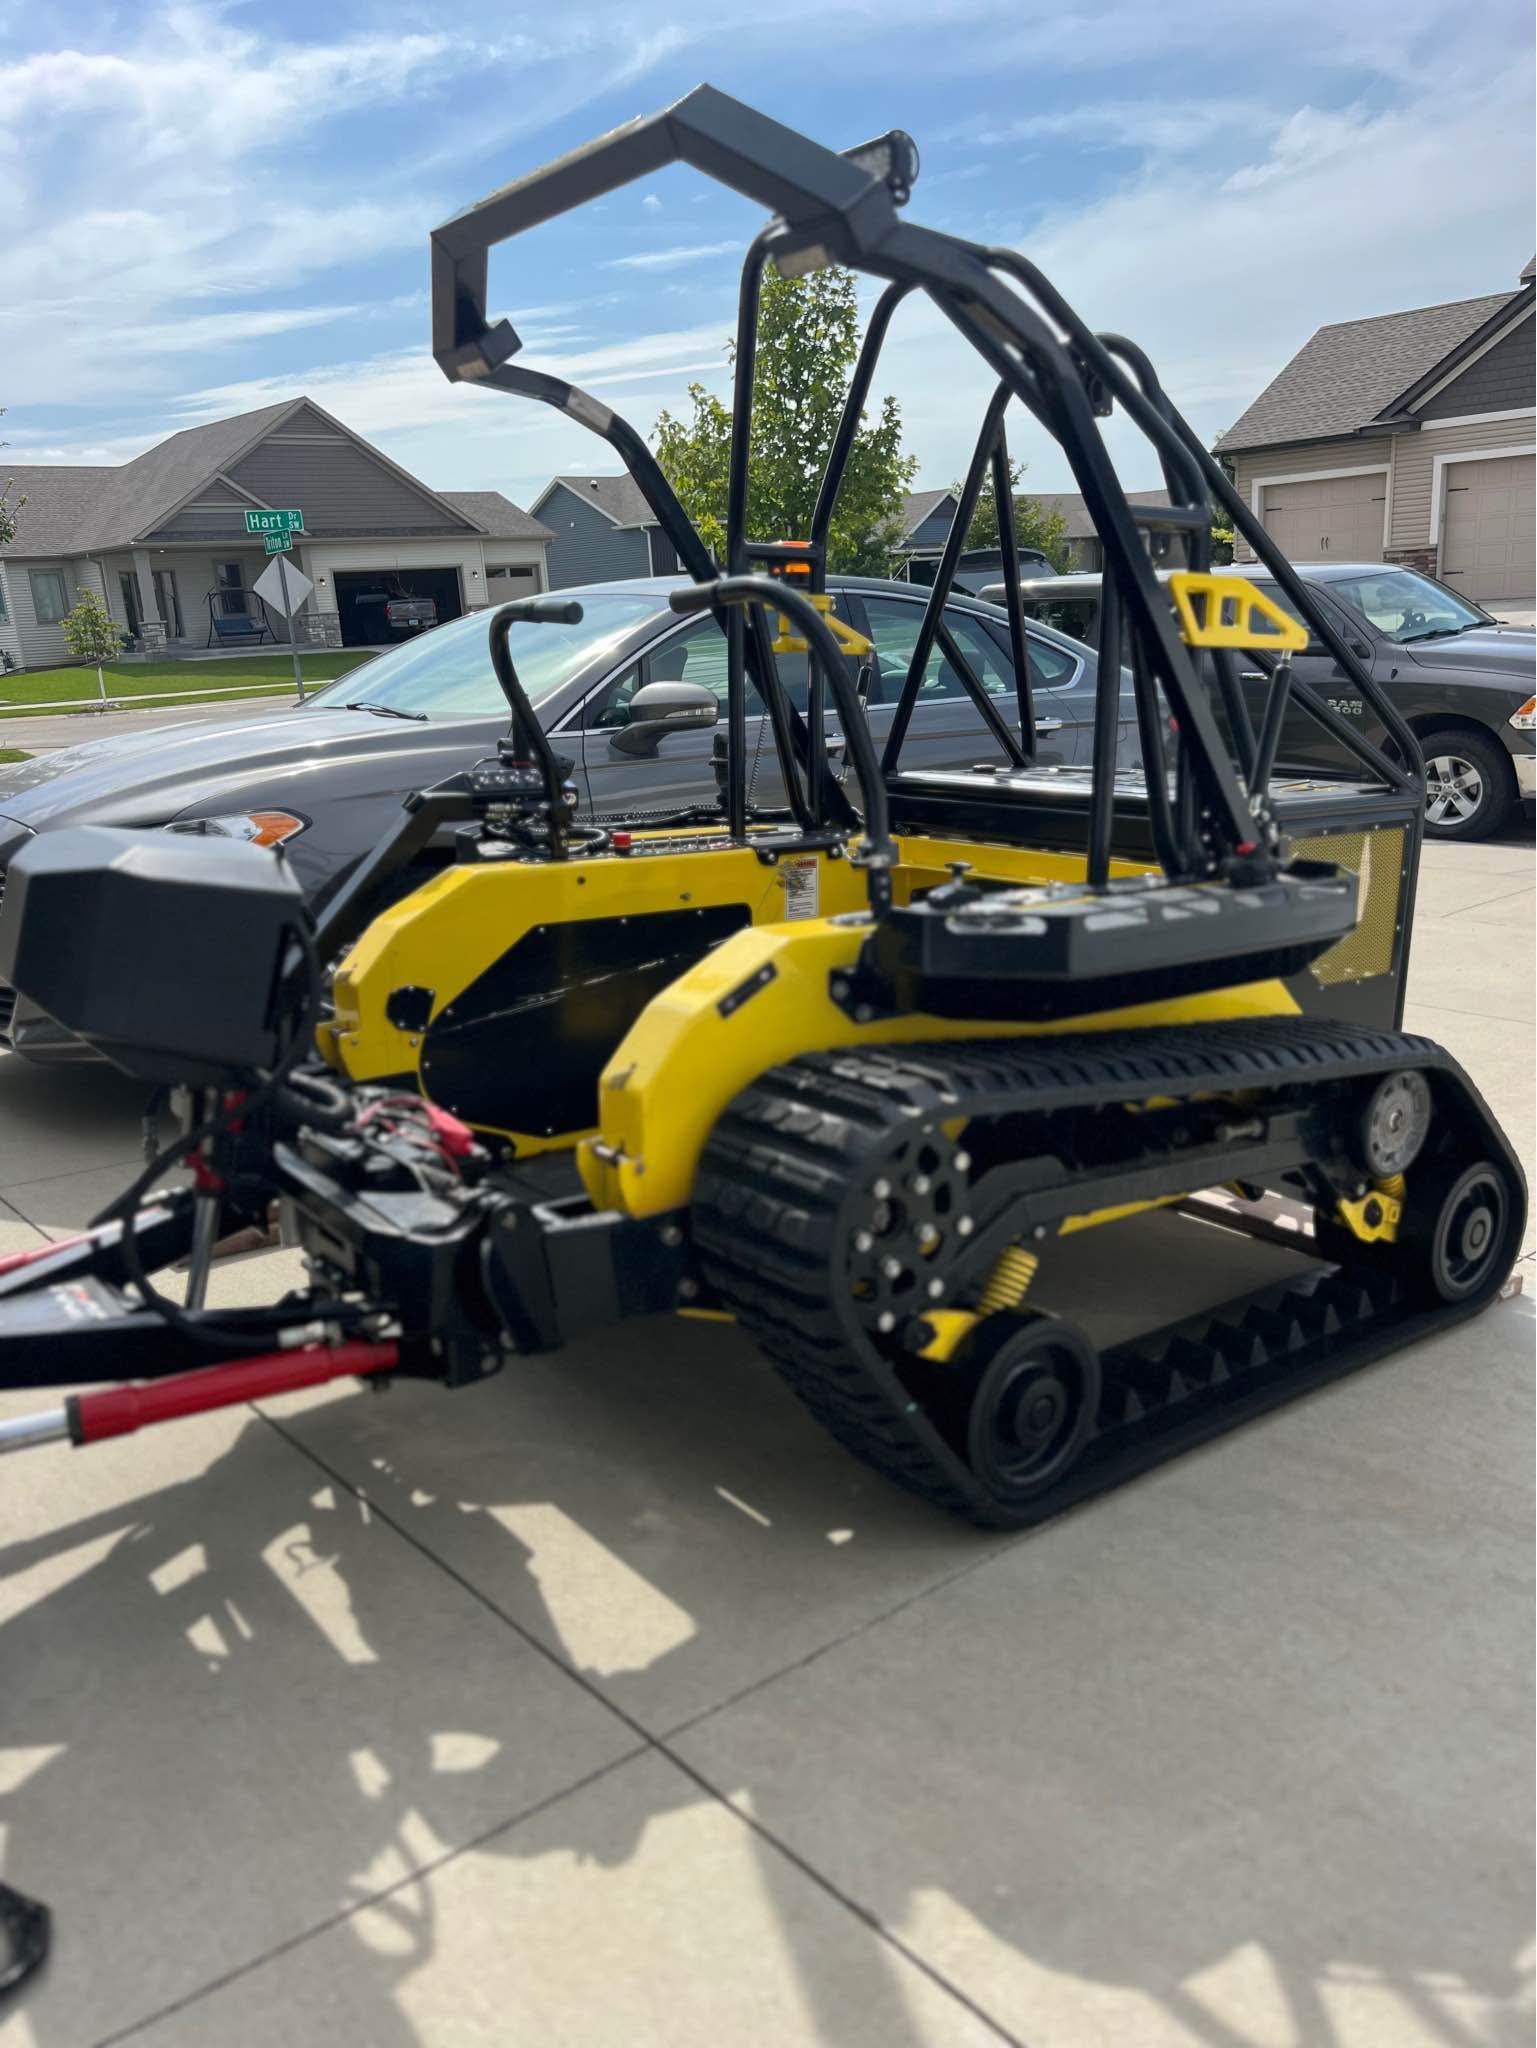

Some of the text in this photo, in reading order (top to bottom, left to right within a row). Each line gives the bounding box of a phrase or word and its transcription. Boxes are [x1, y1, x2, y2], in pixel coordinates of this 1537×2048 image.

[249, 512, 297, 528] Hart Dr
[1328, 699, 1362, 707] RAM
